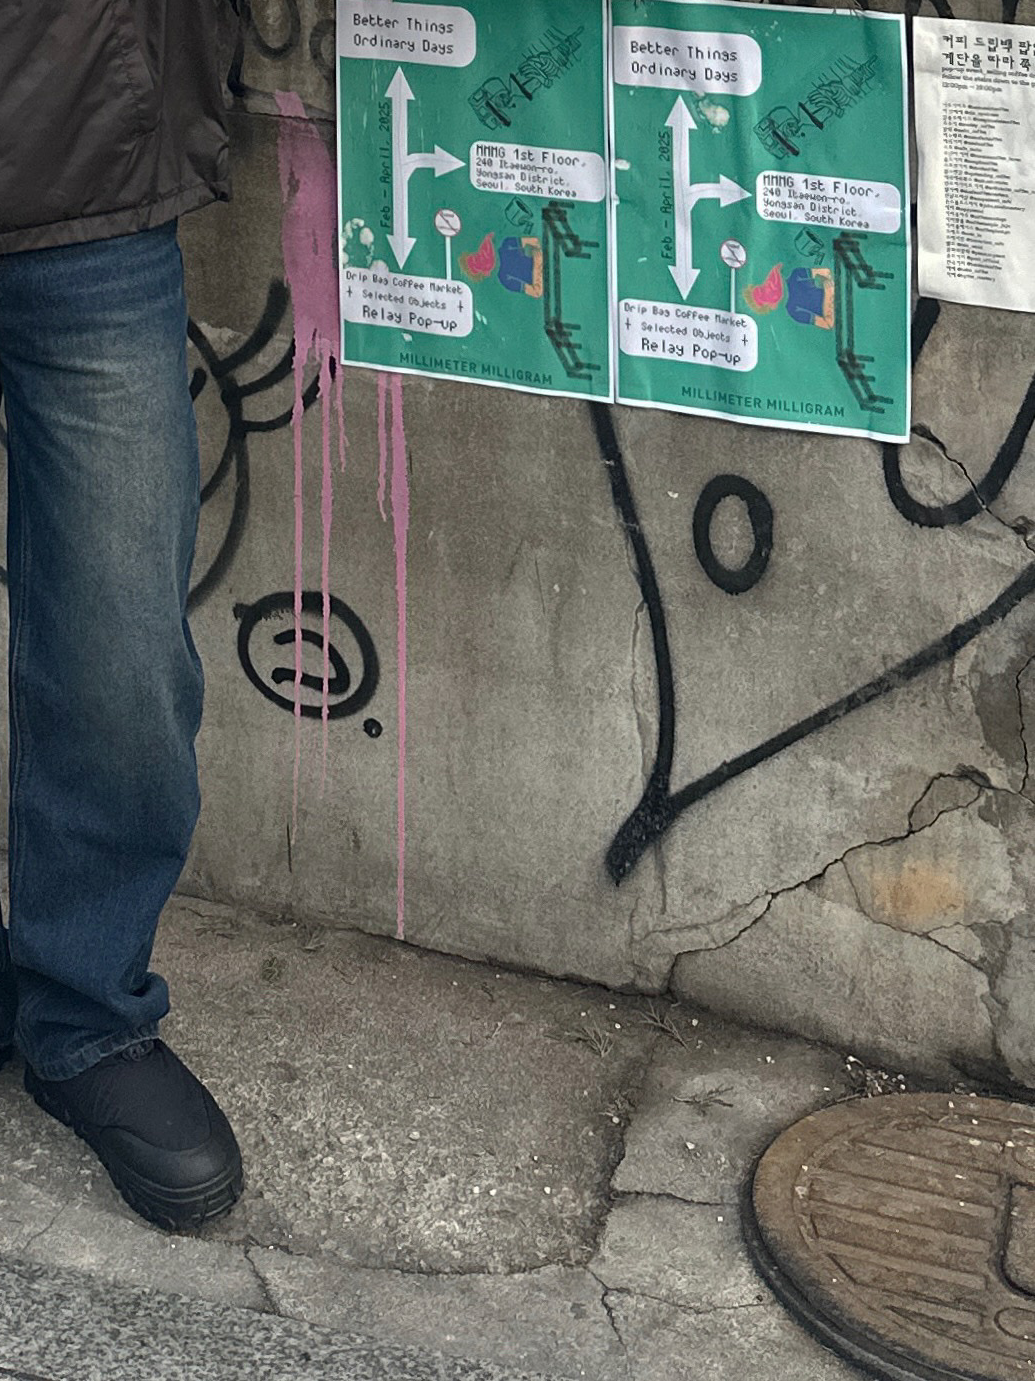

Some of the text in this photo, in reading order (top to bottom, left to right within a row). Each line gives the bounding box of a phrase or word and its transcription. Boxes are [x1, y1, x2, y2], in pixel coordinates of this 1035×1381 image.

[353, 13, 454, 34] Better Things
[353, 34, 454, 56] Ordinary Days
[630, 41, 738, 62] Better Things
[942, 34, 967, 49] 커피
[973, 37, 1013, 53] 드립백
[631, 61, 738, 83] Ordinary Days
[378, 101, 390, 132] 2025
[476, 144, 506, 158] MMMG
[513, 147, 535, 161] 1st
[658, 131, 671, 162] 2025
[476, 156, 493, 167] 240
[476, 168, 515, 181] Yongsan
[763, 174, 794, 188] MMMG
[802, 178, 826, 192] 1st
[515, 182, 543, 195] South
[548, 185, 577, 198] Korea
[763, 187, 781, 198] 240
[763, 197, 805, 212] Yongsan
[380, 205, 391, 228] Feb
[804, 211, 834, 225] South
[839, 215, 870, 229] Korea
[661, 236, 673, 260] Feb
[345, 271, 463, 295] Drip Bag Coffee Market
[362, 289, 404, 304] Selected
[408, 294, 447, 310] Objects
[362, 305, 458, 331] Relay Pop-up
[624, 302, 748, 328] Drip Bag Coffee Market
[641, 321, 688, 337] Selected
[692, 327, 731, 343] Objects
[641, 337, 741, 366] Relay Pop-up
[399, 352, 553, 385] MILLIMETER MILLIGRAM
[681, 386, 845, 417] MILLIMETER MILLIGRAM
